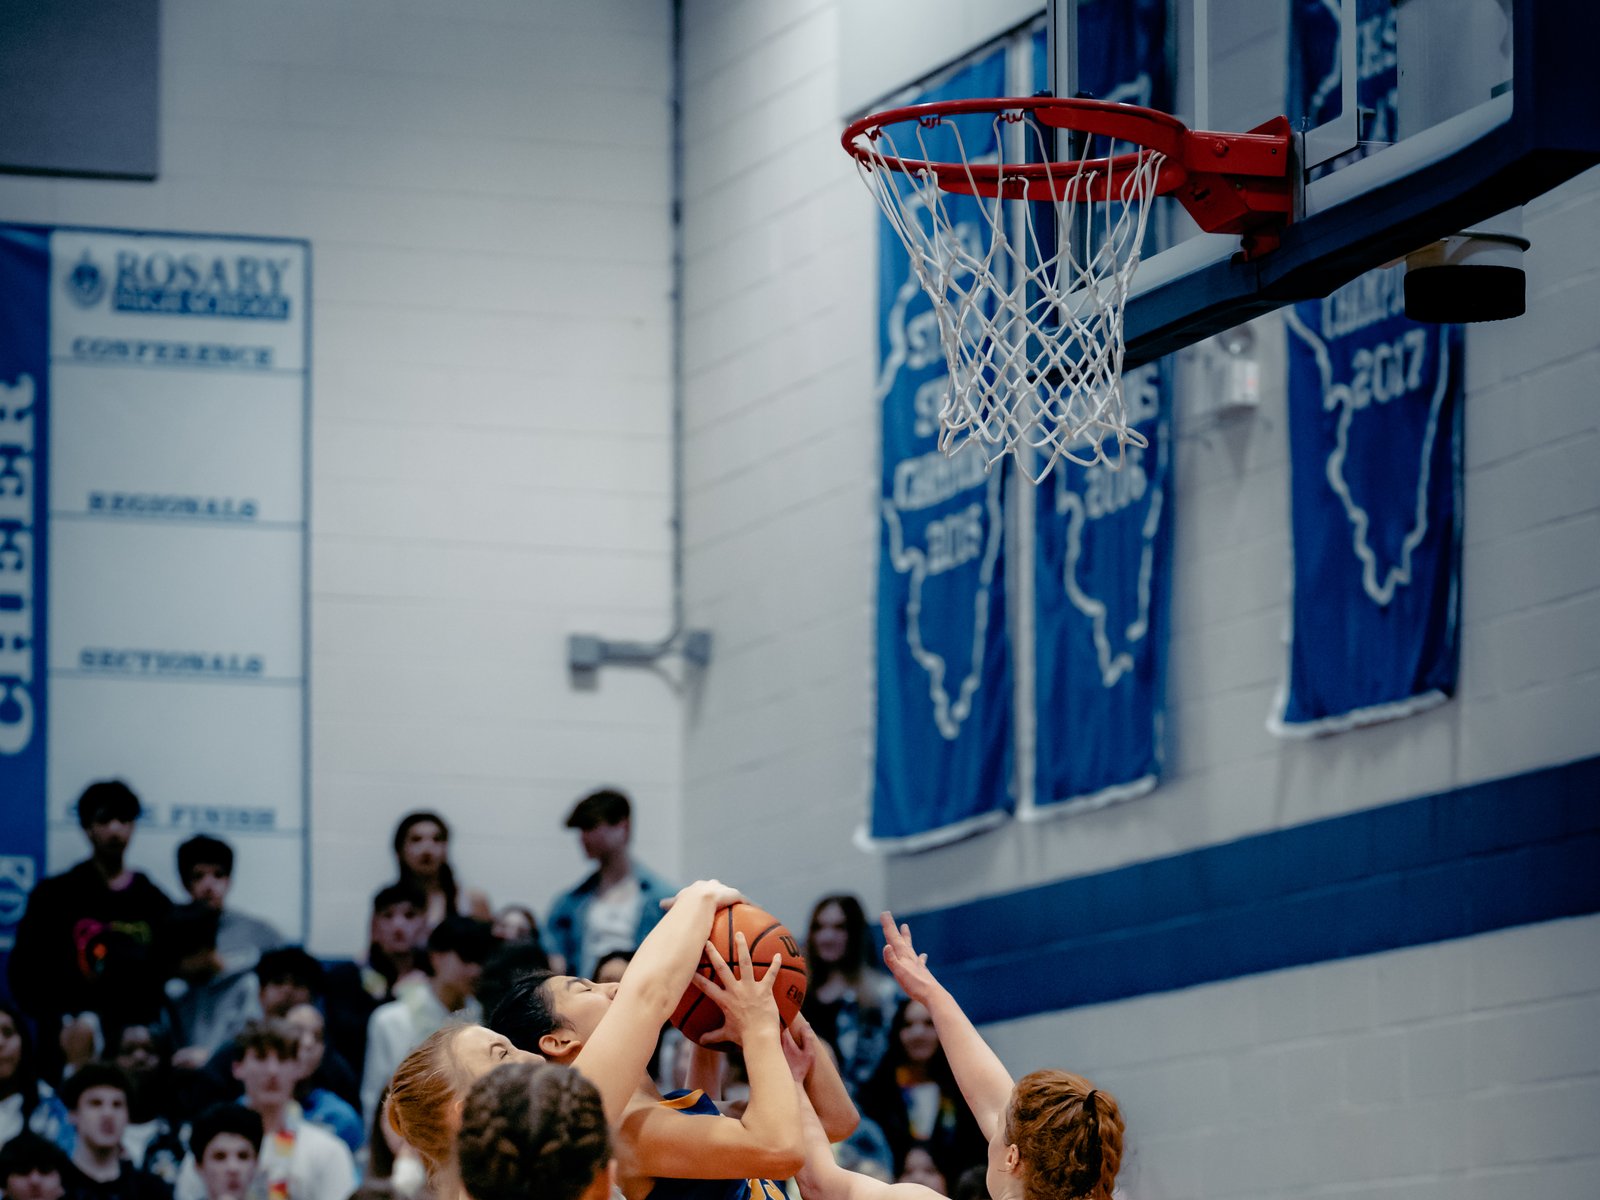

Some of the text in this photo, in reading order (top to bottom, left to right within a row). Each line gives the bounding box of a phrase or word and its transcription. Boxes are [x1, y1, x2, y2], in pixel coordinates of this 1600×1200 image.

[116, 250, 292, 297] ROSARY
[73, 336, 274, 366] CONFERENCE
[1352, 327, 1426, 409] 2017
[88, 492, 258, 518] REGIONALS
[79, 647, 264, 674] SECTIONALS
